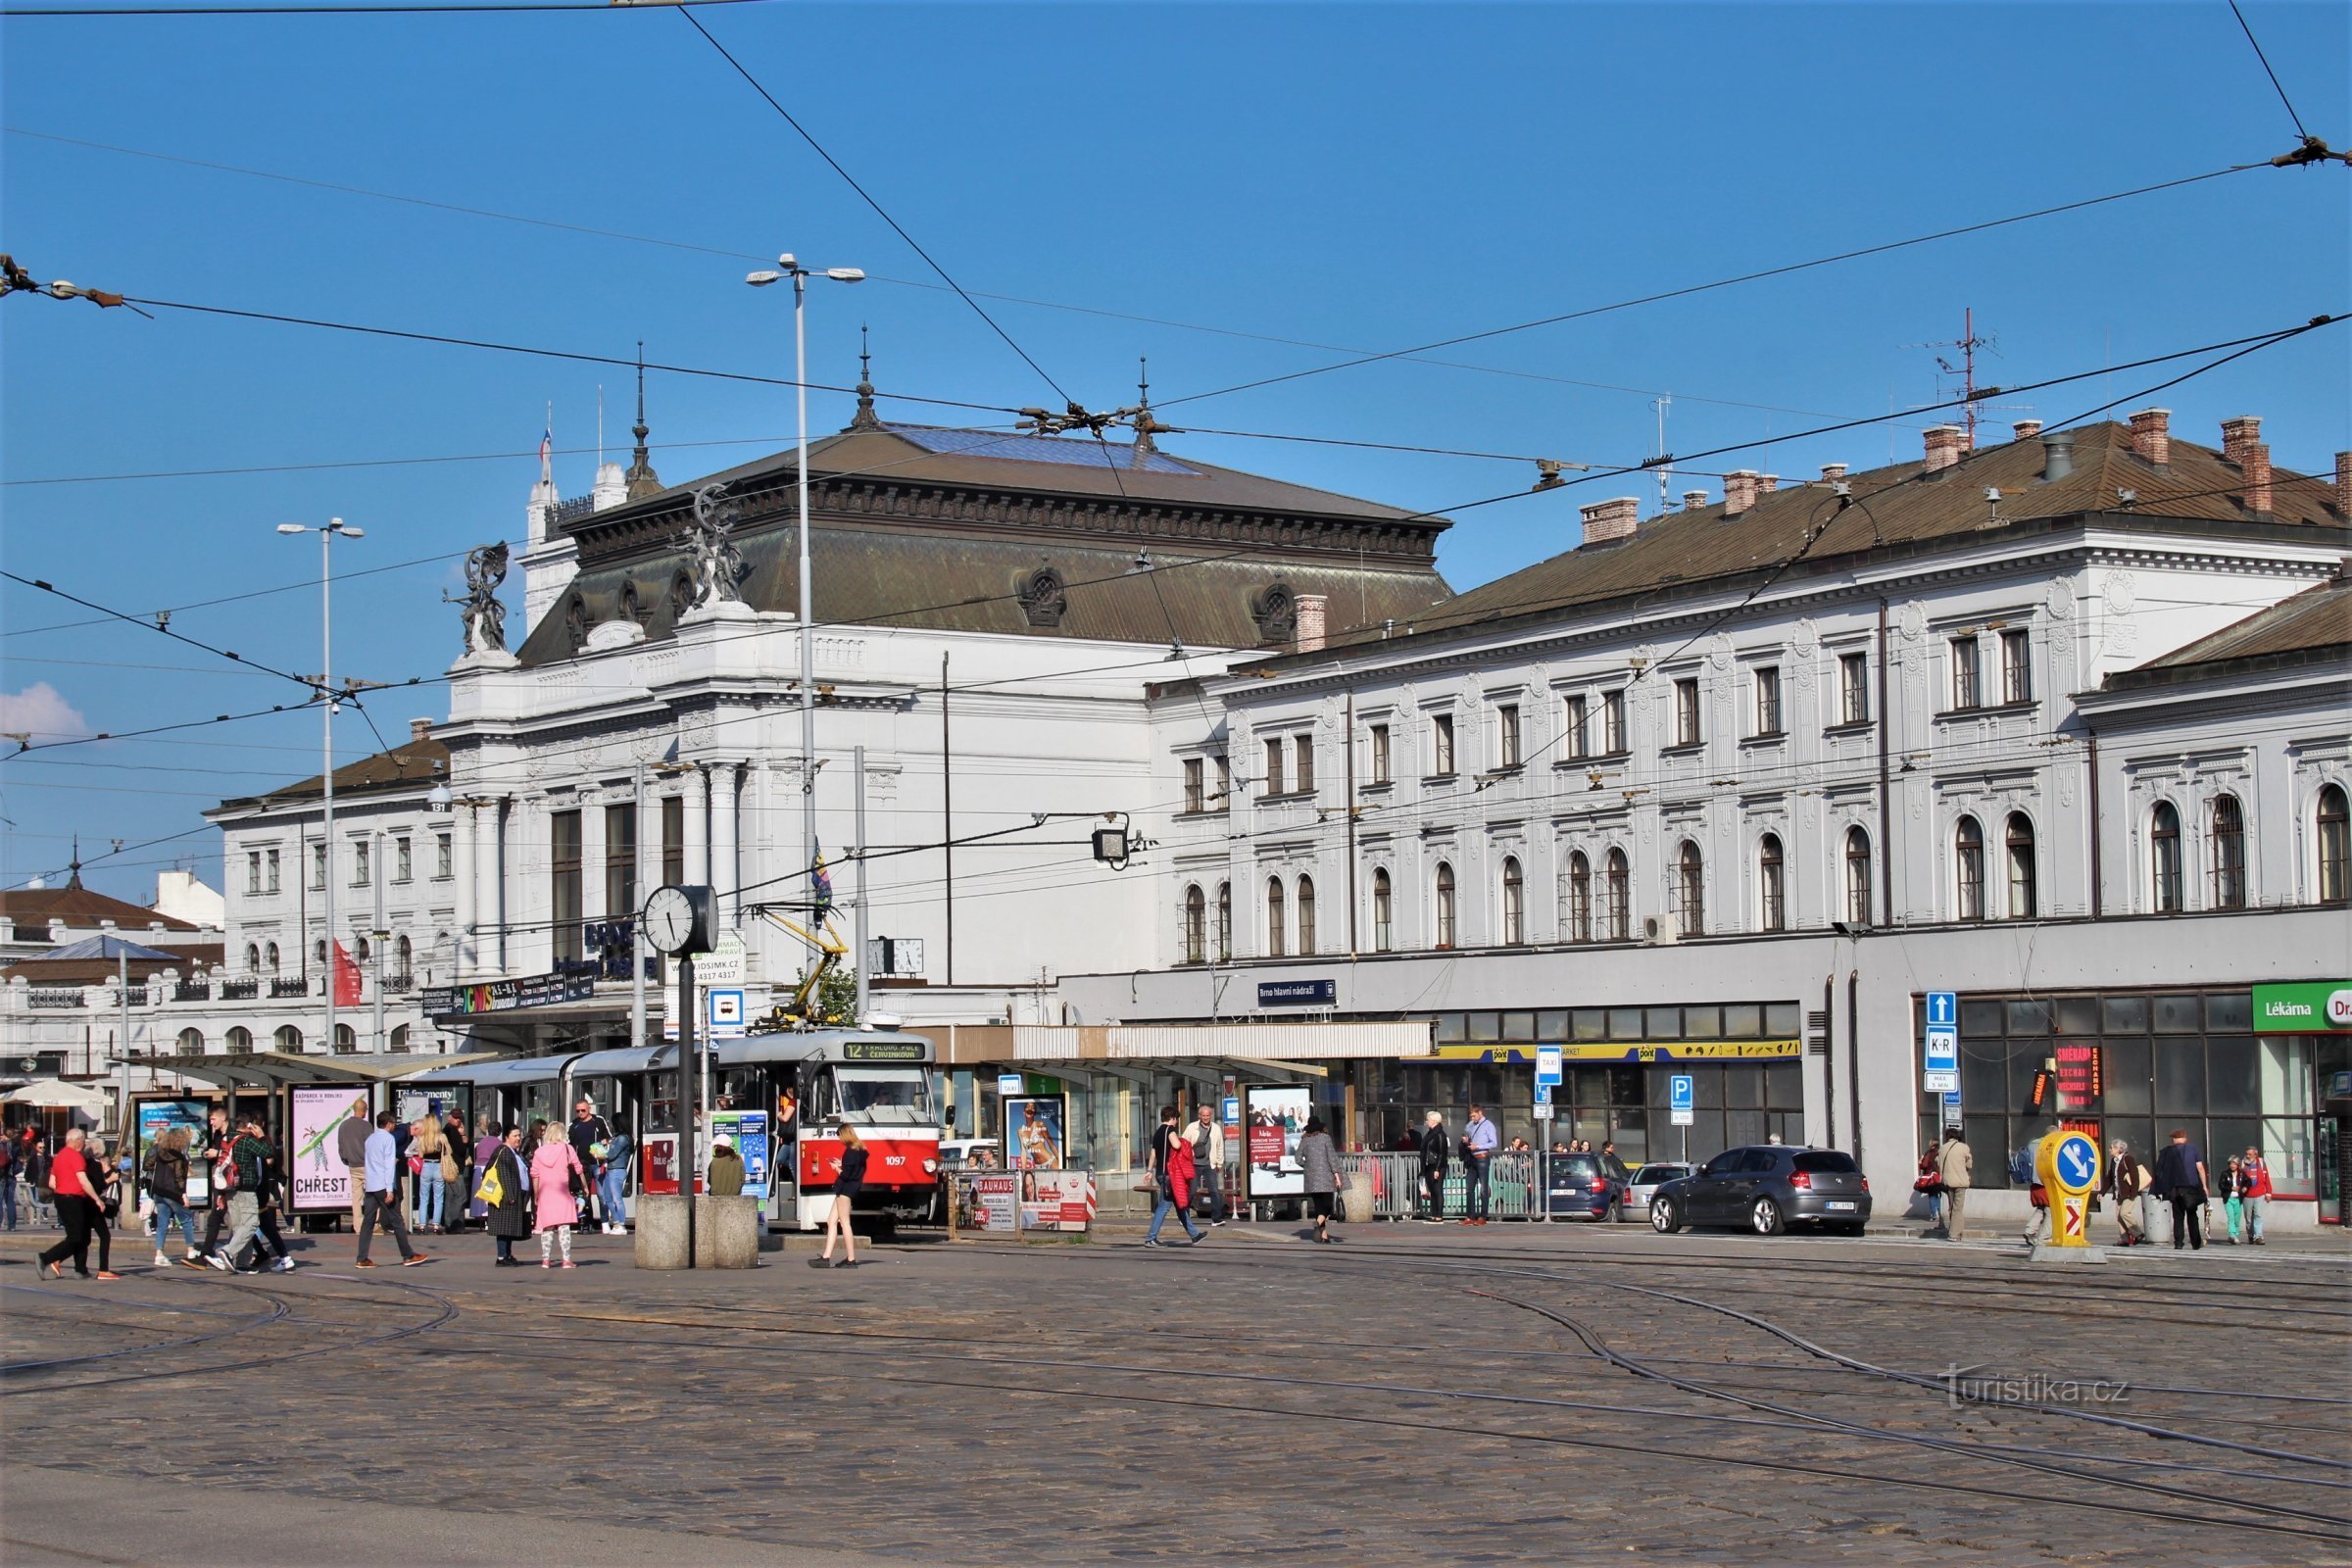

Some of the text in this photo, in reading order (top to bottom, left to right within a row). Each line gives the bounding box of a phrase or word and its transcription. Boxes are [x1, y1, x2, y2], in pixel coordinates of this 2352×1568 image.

[1259, 984, 1314, 997] Brno hlavní nádraží
[2266, 1002, 2312, 1016] Lékárna
[848, 1045, 861, 1058] 12
[1675, 1080, 1688, 1099] P
[885, 1156, 906, 1166] 1097
[295, 1175, 348, 1193] CHŘEST
[979, 1180, 1013, 1191] BAUHAUS
